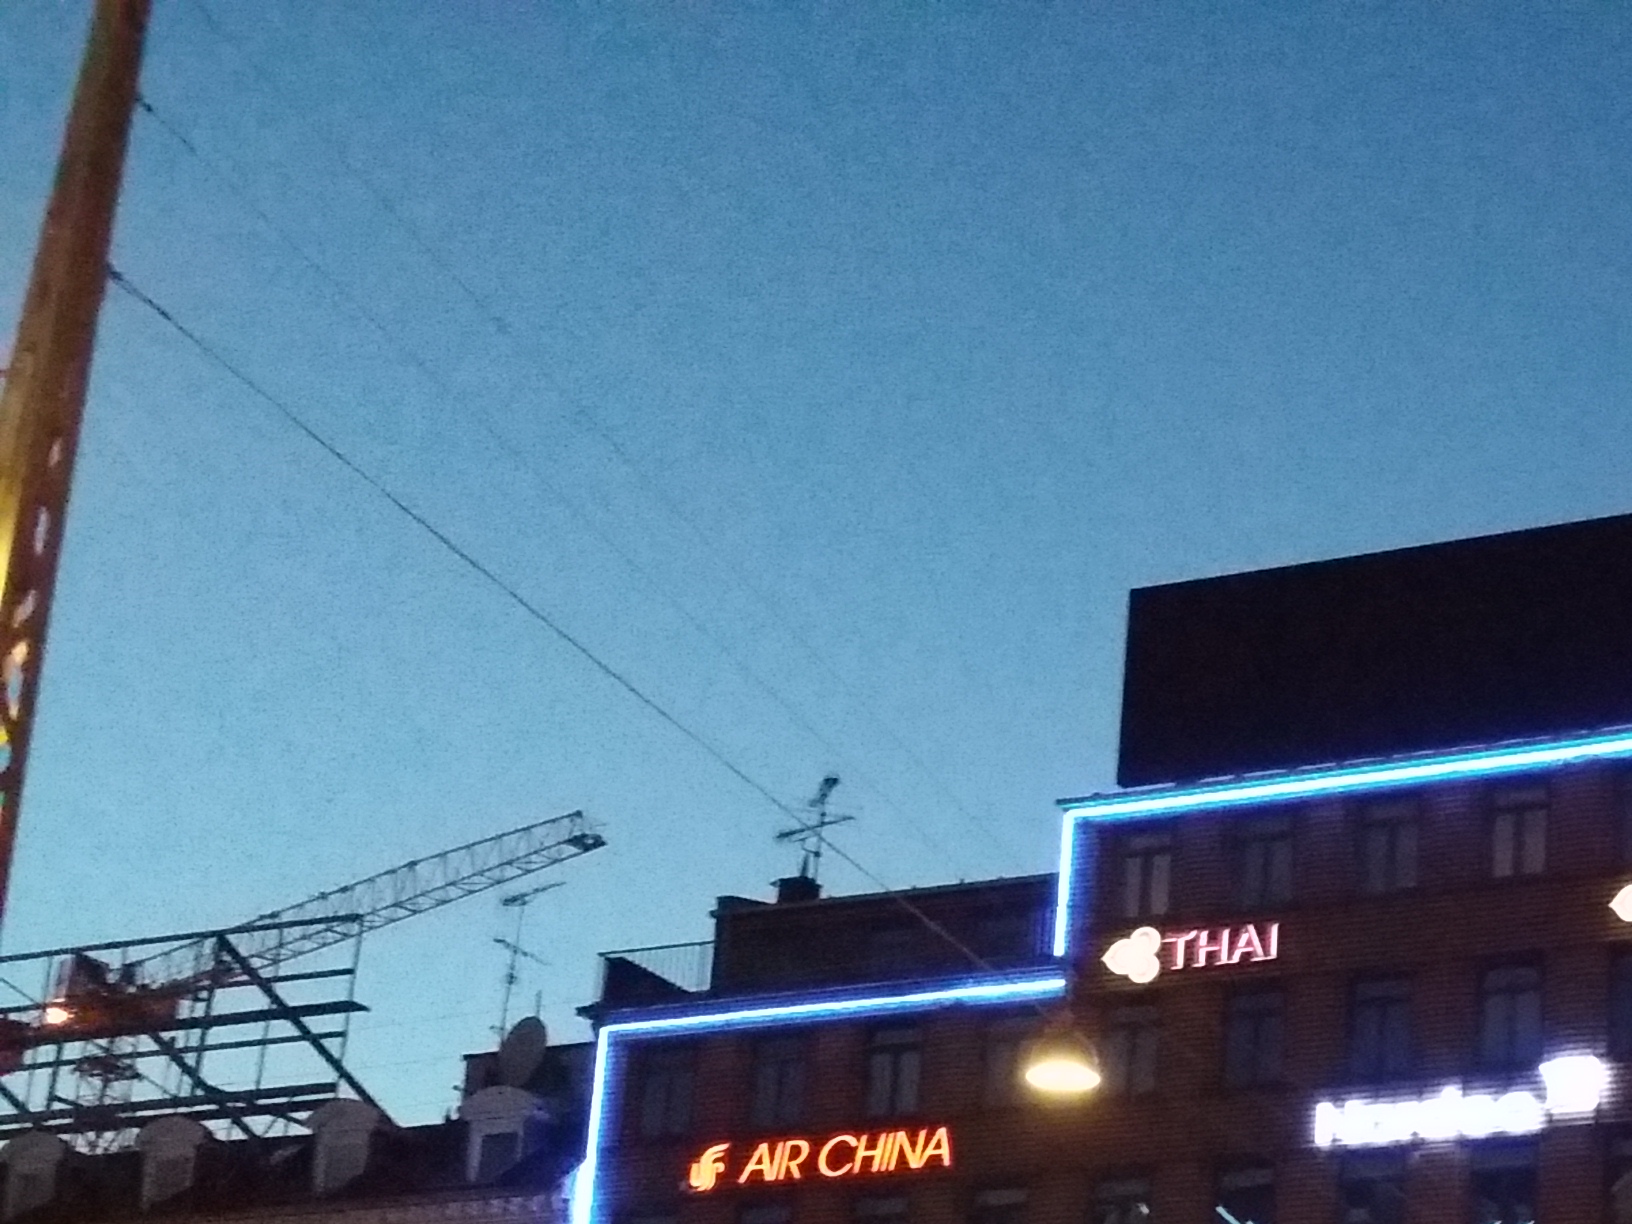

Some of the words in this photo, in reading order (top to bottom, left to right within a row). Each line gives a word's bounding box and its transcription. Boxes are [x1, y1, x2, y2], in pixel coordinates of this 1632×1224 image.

[1161, 922, 1280, 970] THAI
[737, 1139, 810, 1184] AIR
[817, 1126, 952, 1177] CHINA
